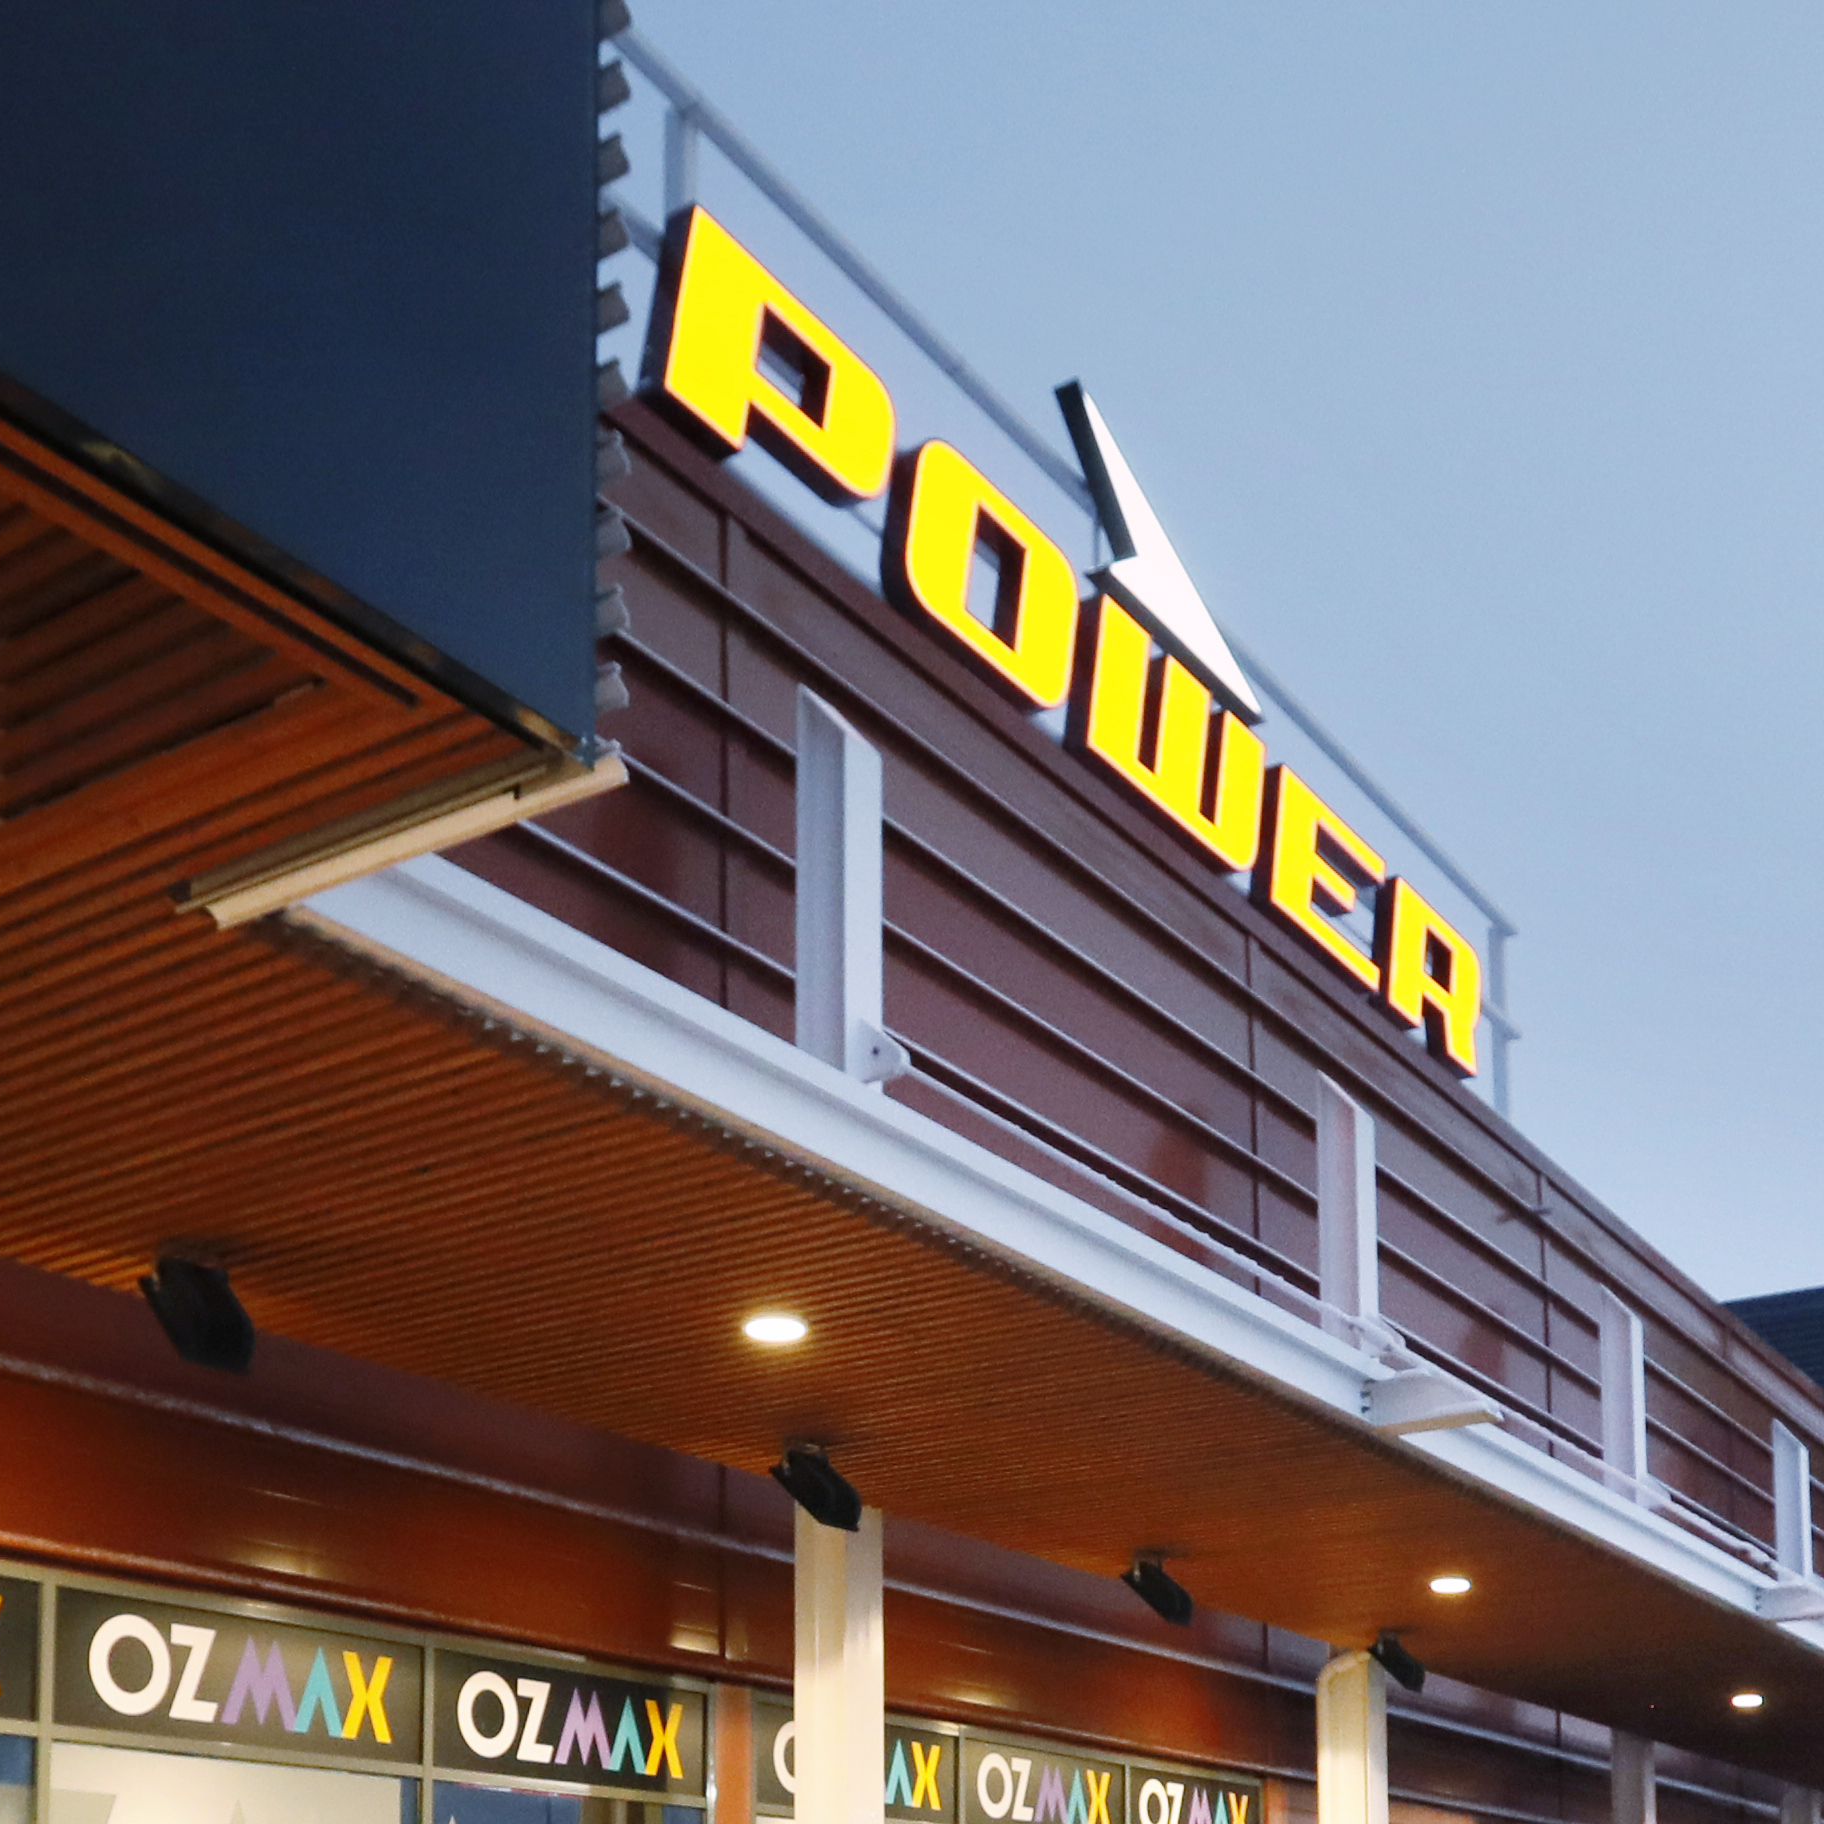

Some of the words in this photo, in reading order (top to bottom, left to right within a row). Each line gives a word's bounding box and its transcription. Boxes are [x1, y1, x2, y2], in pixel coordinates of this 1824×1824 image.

[639, 203, 1482, 1078] POWER
[88, 1613, 393, 1744] OZMAX
[457, 1670, 684, 1779] OZMAX
